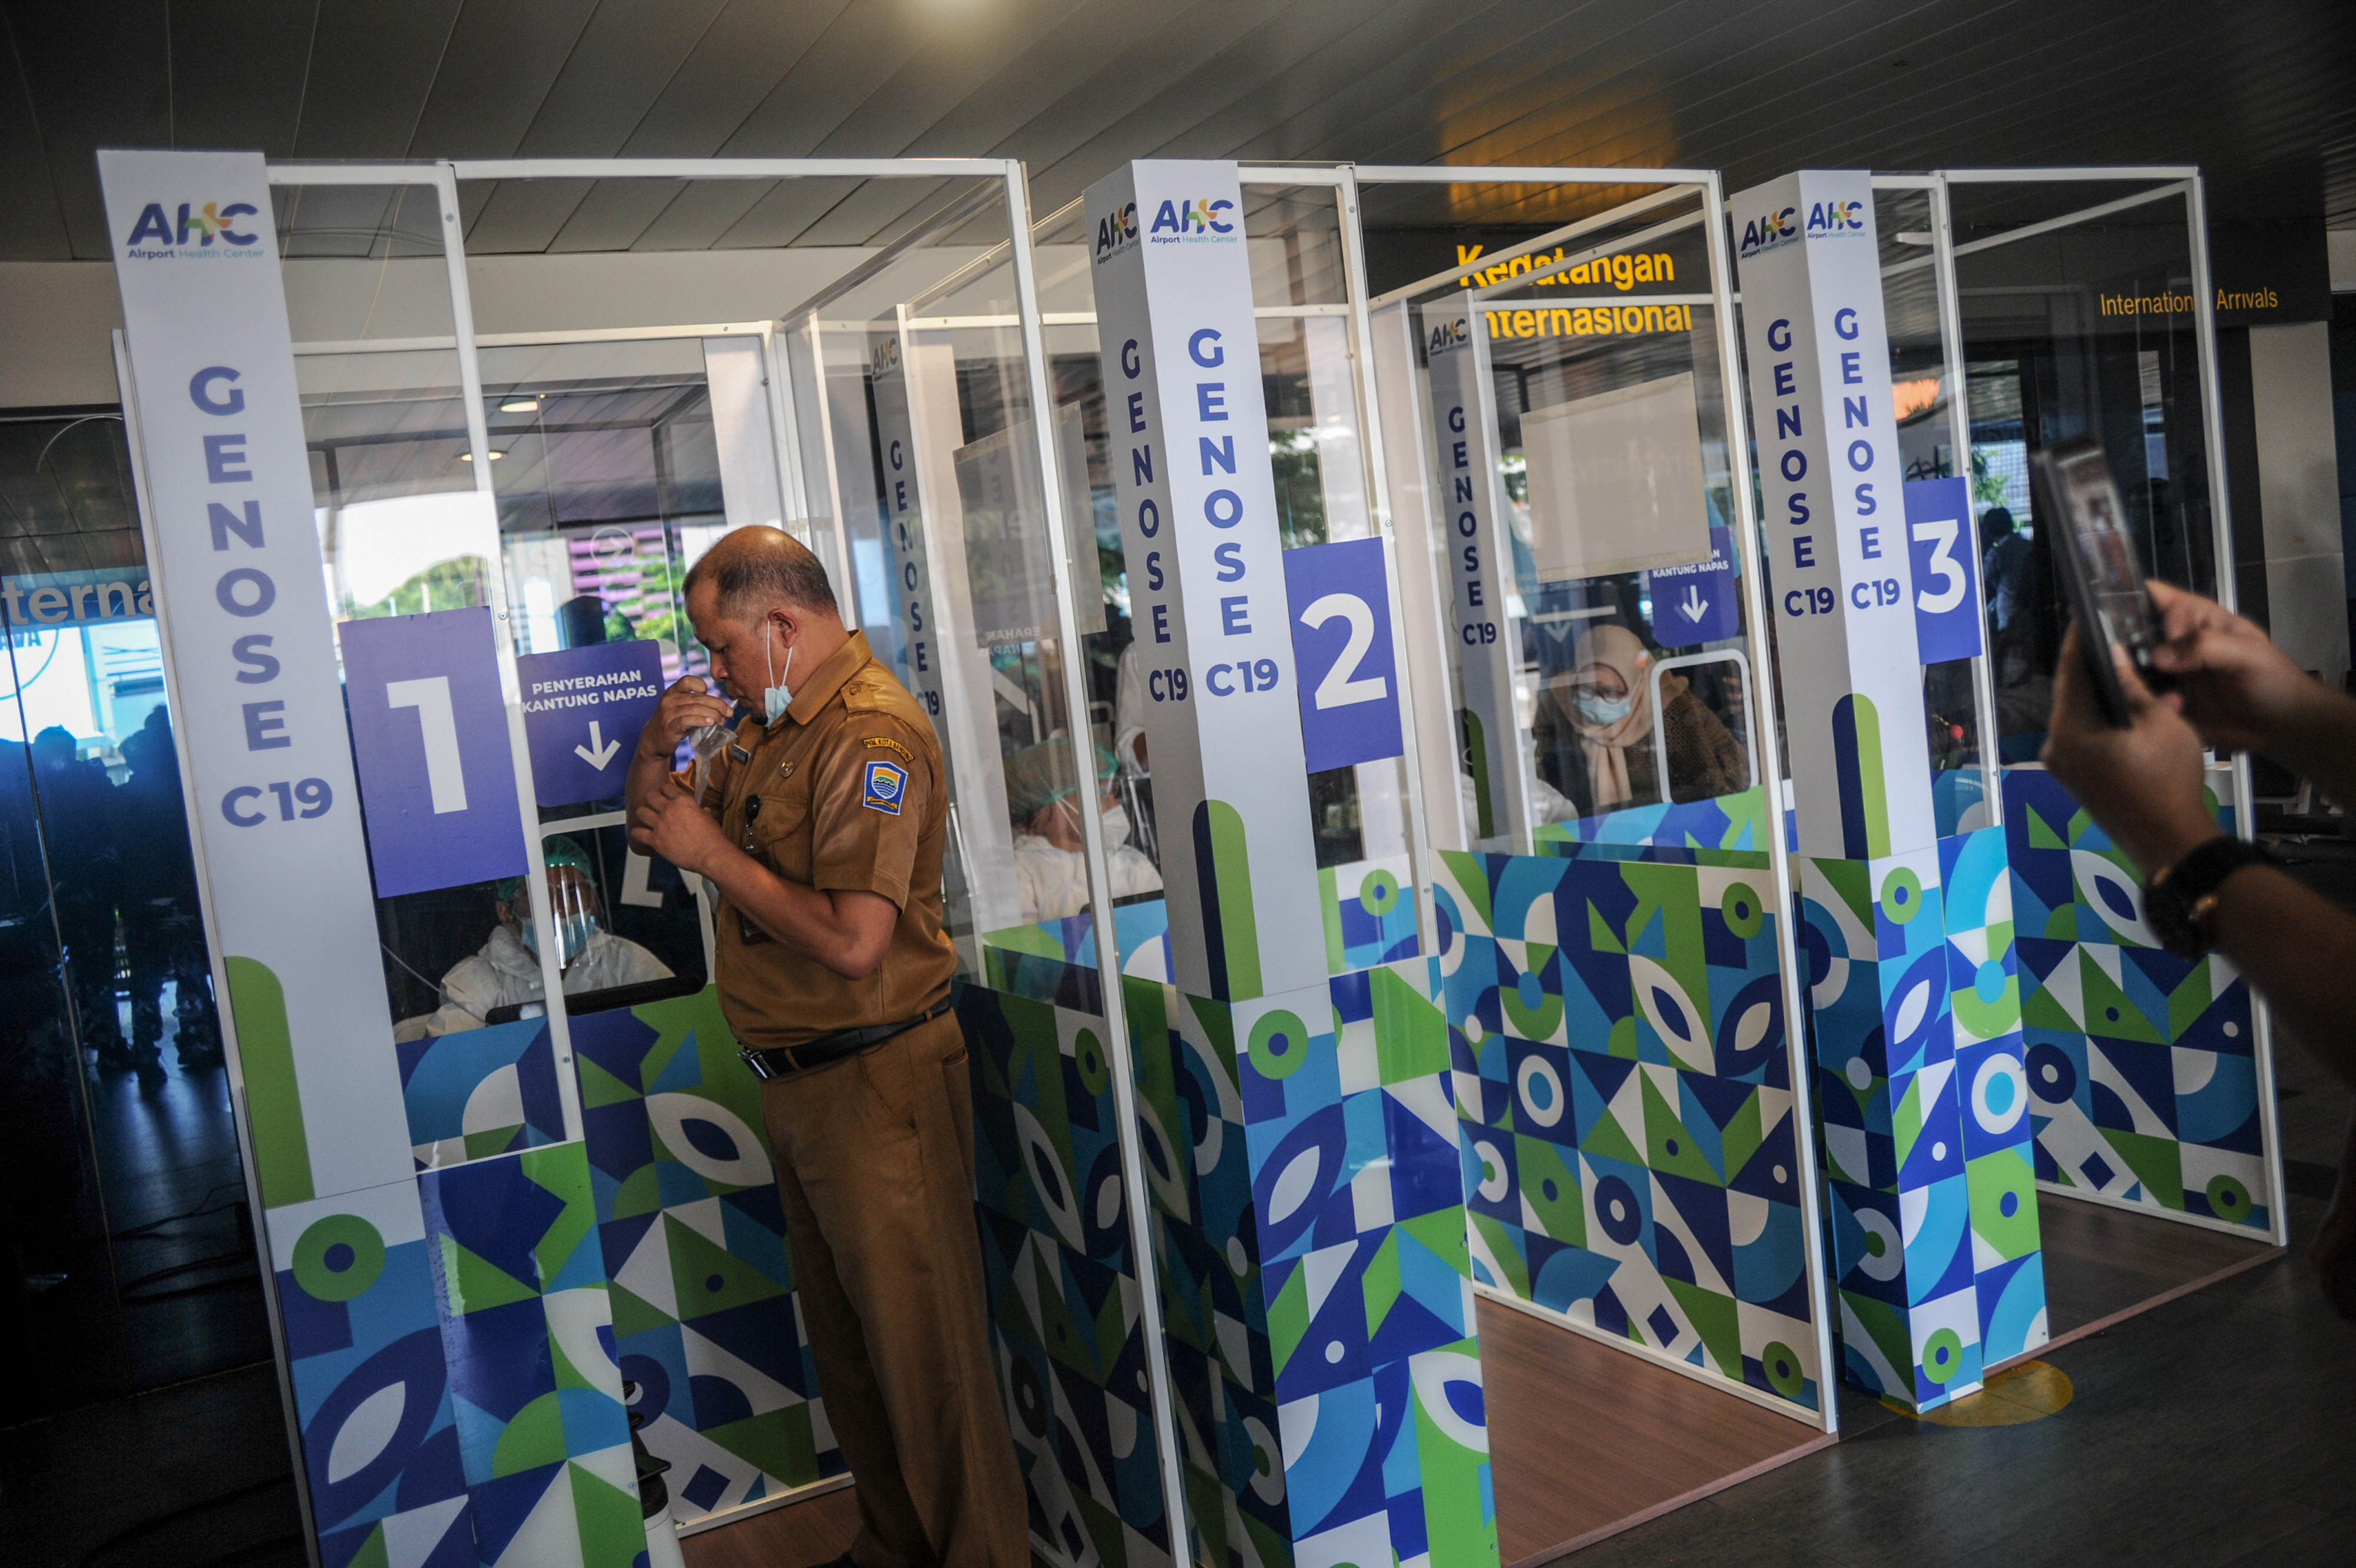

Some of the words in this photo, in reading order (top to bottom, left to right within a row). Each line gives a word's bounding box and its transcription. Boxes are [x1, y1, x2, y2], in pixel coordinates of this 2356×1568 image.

[127, 202, 259, 246] AHC
[1097, 202, 1137, 255] AHC
[1150, 199, 1234, 234] AHC
[1740, 207, 1796, 252] AHC
[1806, 201, 1863, 230] AHC
[128, 249, 176, 260] Airport
[178, 249, 220, 258] Health
[224, 249, 264, 258] Center
[1097, 253, 1112, 265] Airport
[1112, 244, 1126, 257] Health
[1126, 238, 1140, 250] Center
[1151, 236, 1180, 244] Airport
[1741, 248, 1761, 259] Airport
[1761, 242, 1779, 252] Health
[1780, 236, 1799, 246] Center
[2101, 292, 2194, 316] Internation
[2216, 287, 2278, 310] Arrivals
[1485, 305, 1692, 339] nternasional
[1768, 319, 1816, 568] GENOSE
[1834, 307, 1882, 560] GENOSE
[1121, 339, 1171, 643] GENOSE
[1188, 329, 1252, 636] GENOSE
[1448, 406, 1484, 607] GENOSE
[189, 366, 292, 752] GENOSE
[891, 441, 928, 672] GENOSE
[1653, 564, 1697, 578] KANTUNG
[1699, 560, 1729, 573] NAPAS
[1912, 518, 1966, 614] 3
[1784, 587, 1835, 617] C19
[1851, 578, 1900, 609] C19
[1300, 593, 1388, 710] 2
[1462, 622, 1497, 646] C19
[532, 670, 642, 695] PENYERAHAN
[1149, 668, 1188, 702] C19
[1206, 659, 1279, 696] C19
[522, 692, 600, 714] KANTUNG
[603, 684, 657, 703] NAPAS
[386, 676, 468, 815] 1
[222, 778, 333, 827] C19
